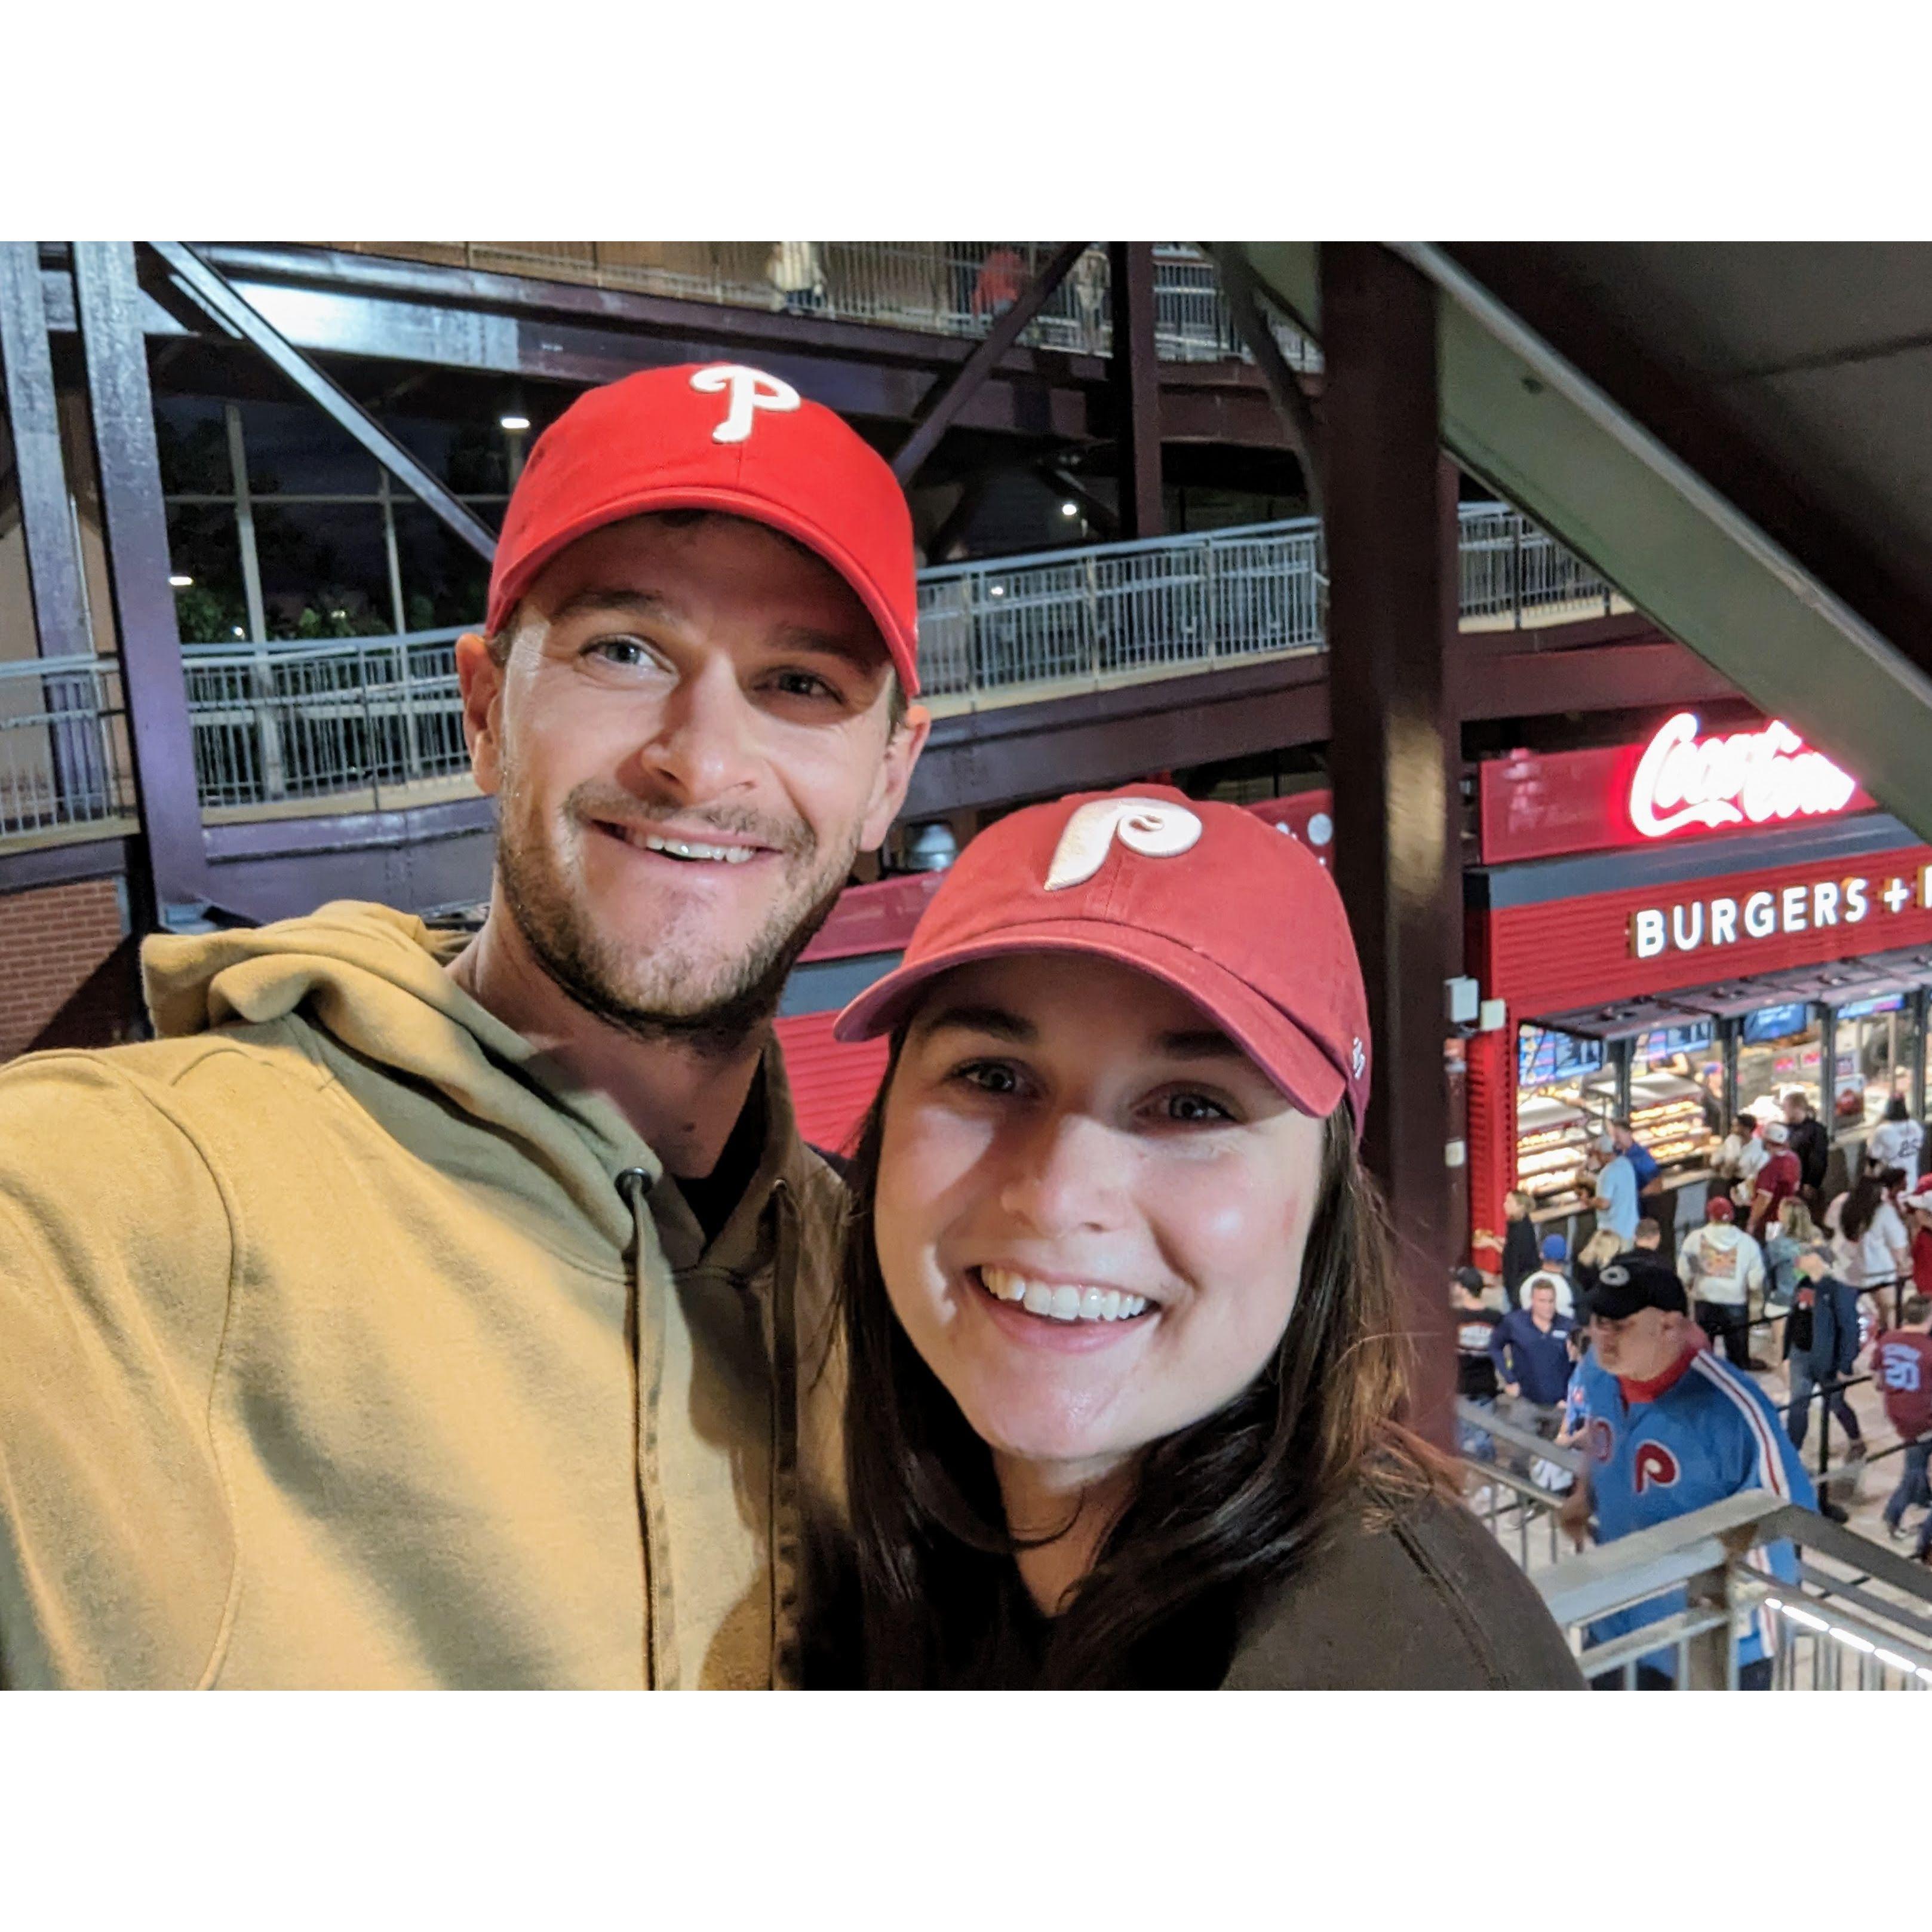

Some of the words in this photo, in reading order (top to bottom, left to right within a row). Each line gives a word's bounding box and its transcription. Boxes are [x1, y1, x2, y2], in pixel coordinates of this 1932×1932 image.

[690, 365, 801, 443] P
[1043, 797, 1202, 891] P
[1636, 877, 1868, 957] BURGERS
[1633, 1439, 1681, 1494] P
